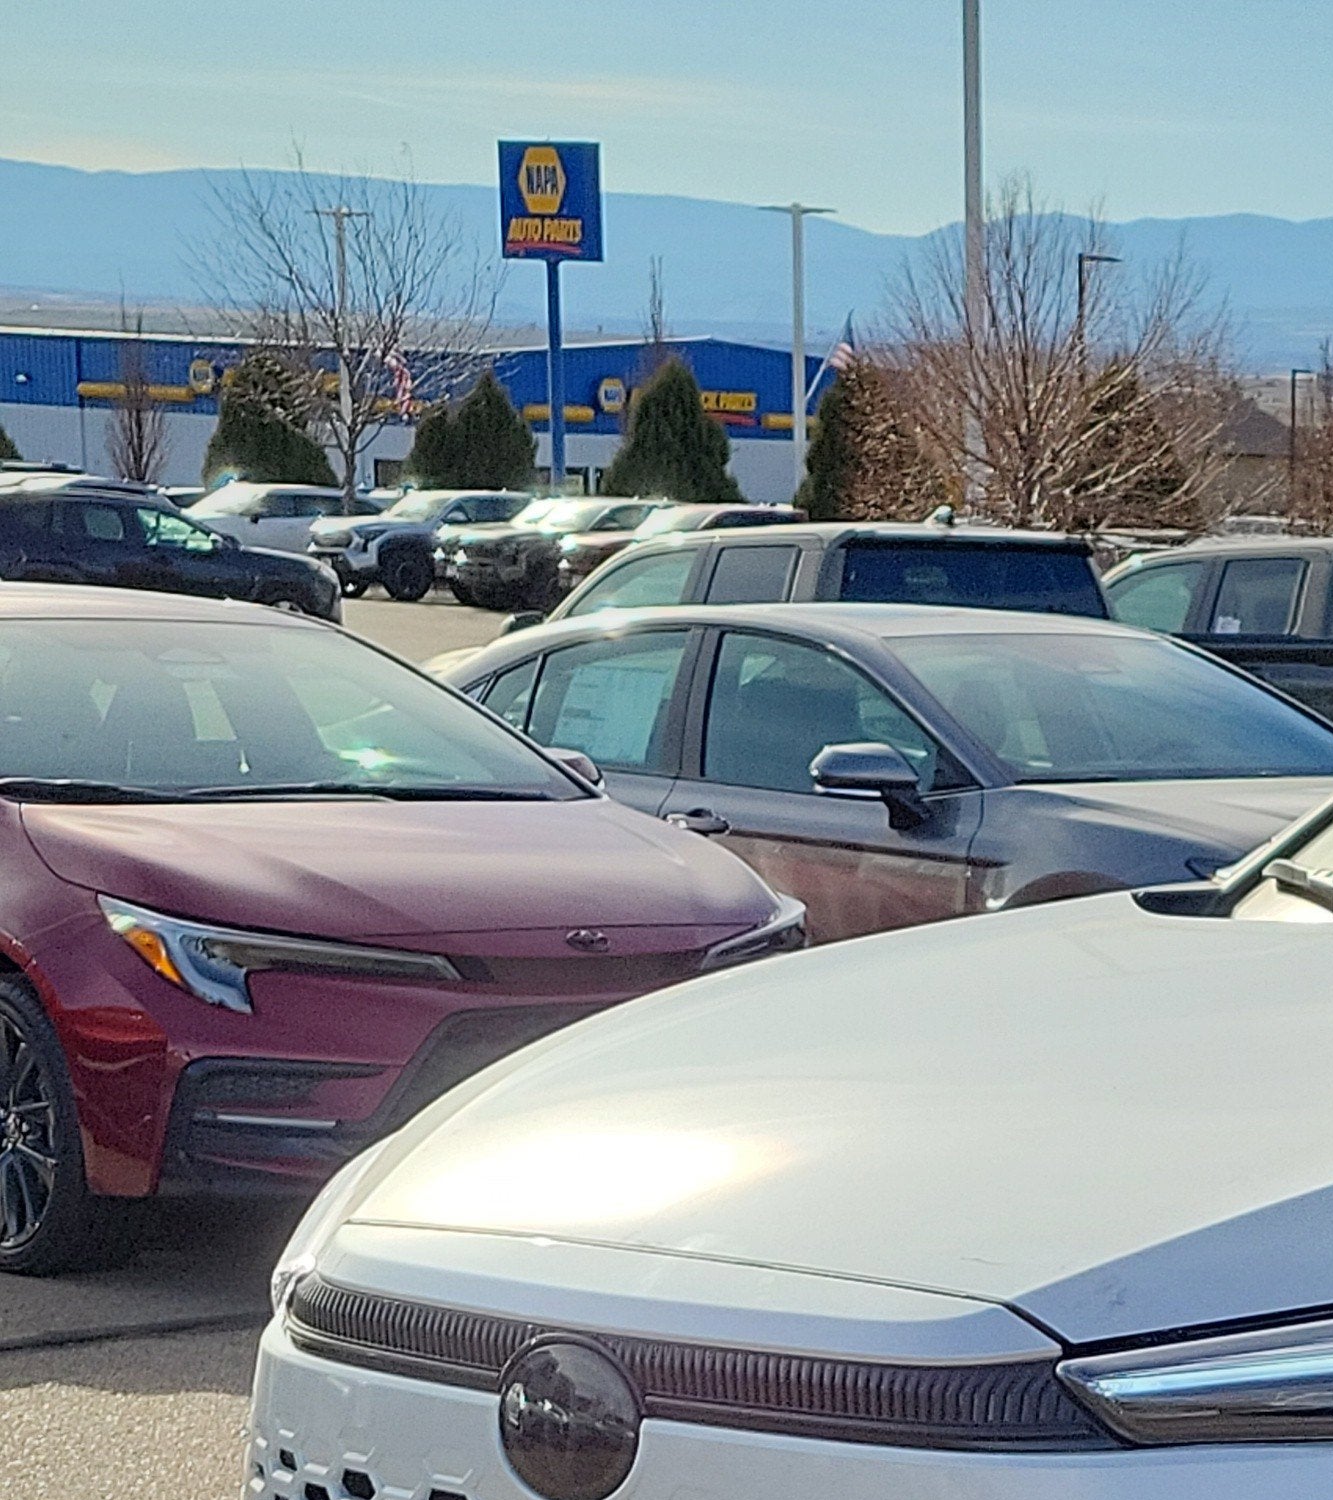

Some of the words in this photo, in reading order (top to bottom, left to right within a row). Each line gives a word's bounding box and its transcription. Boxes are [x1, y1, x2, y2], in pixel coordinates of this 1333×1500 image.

[526, 165, 558, 195] NAPA
[508, 217, 542, 241] AUTO
[543, 217, 582, 244] PARTS
